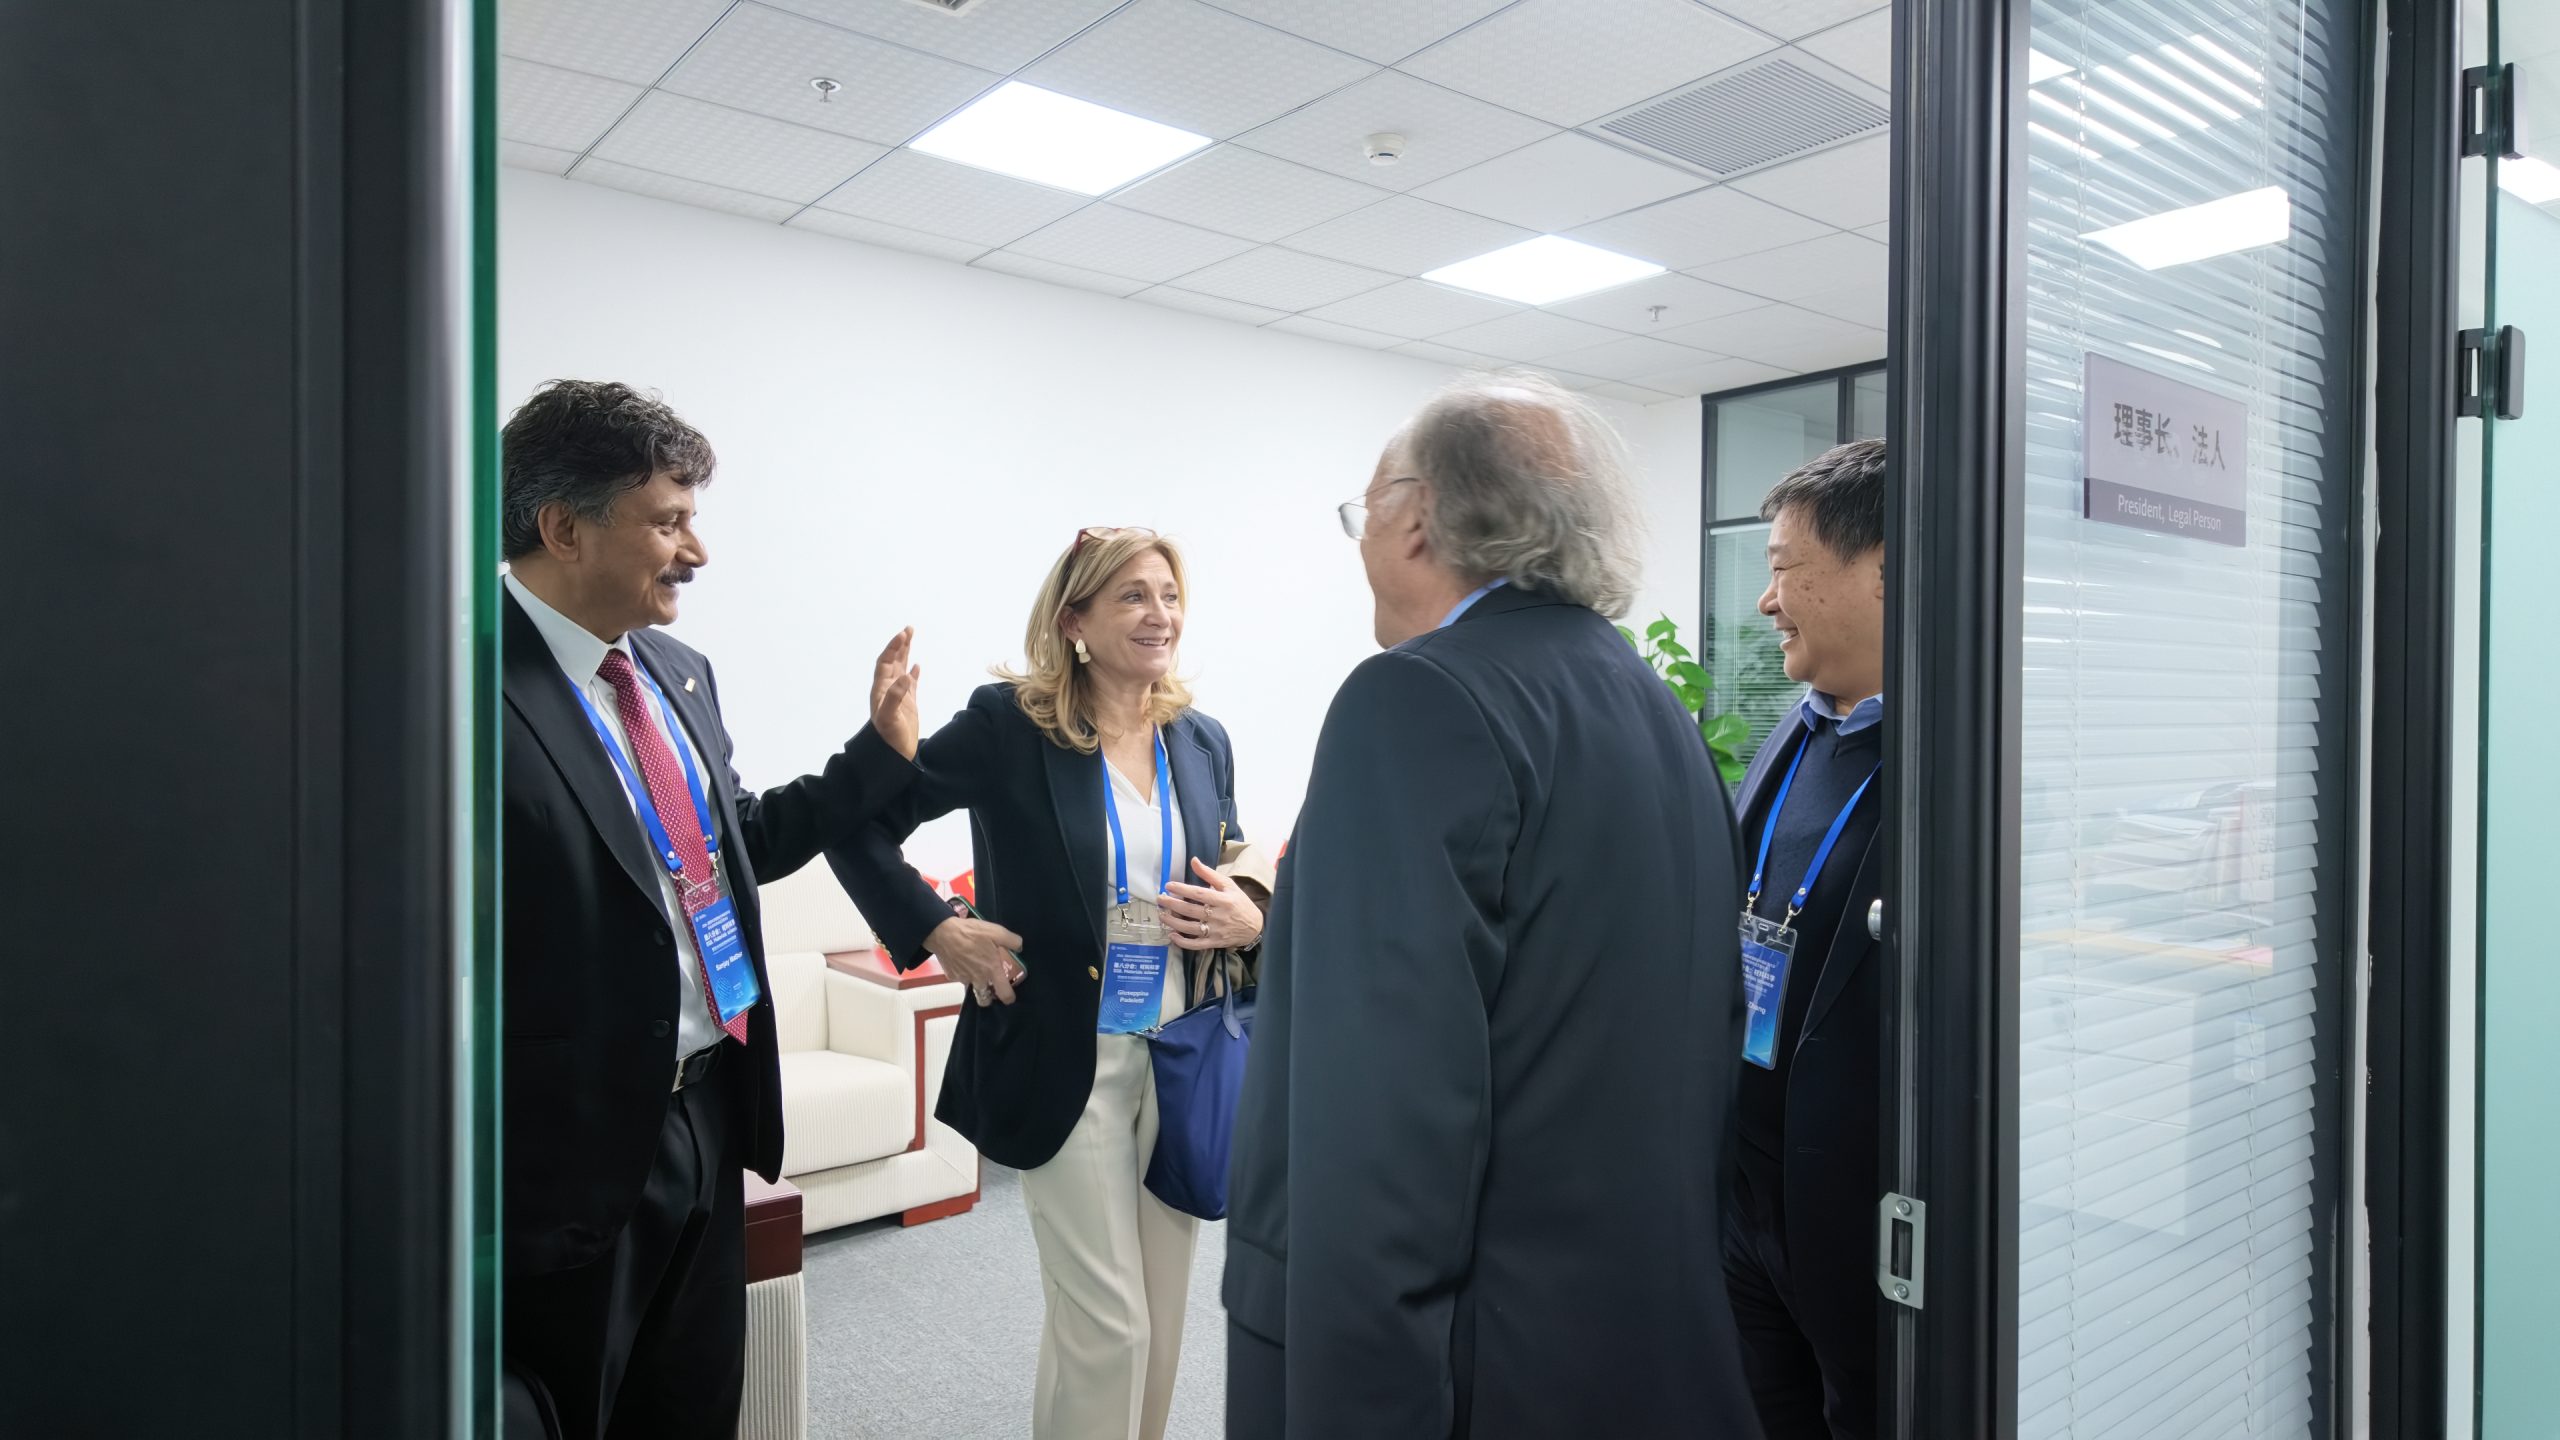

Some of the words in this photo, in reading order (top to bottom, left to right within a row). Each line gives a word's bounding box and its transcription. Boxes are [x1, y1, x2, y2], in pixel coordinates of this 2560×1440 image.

[2118, 494, 2165, 523] President,
[2168, 505, 2192, 528] Legal
[2193, 511, 2222, 532] Person
